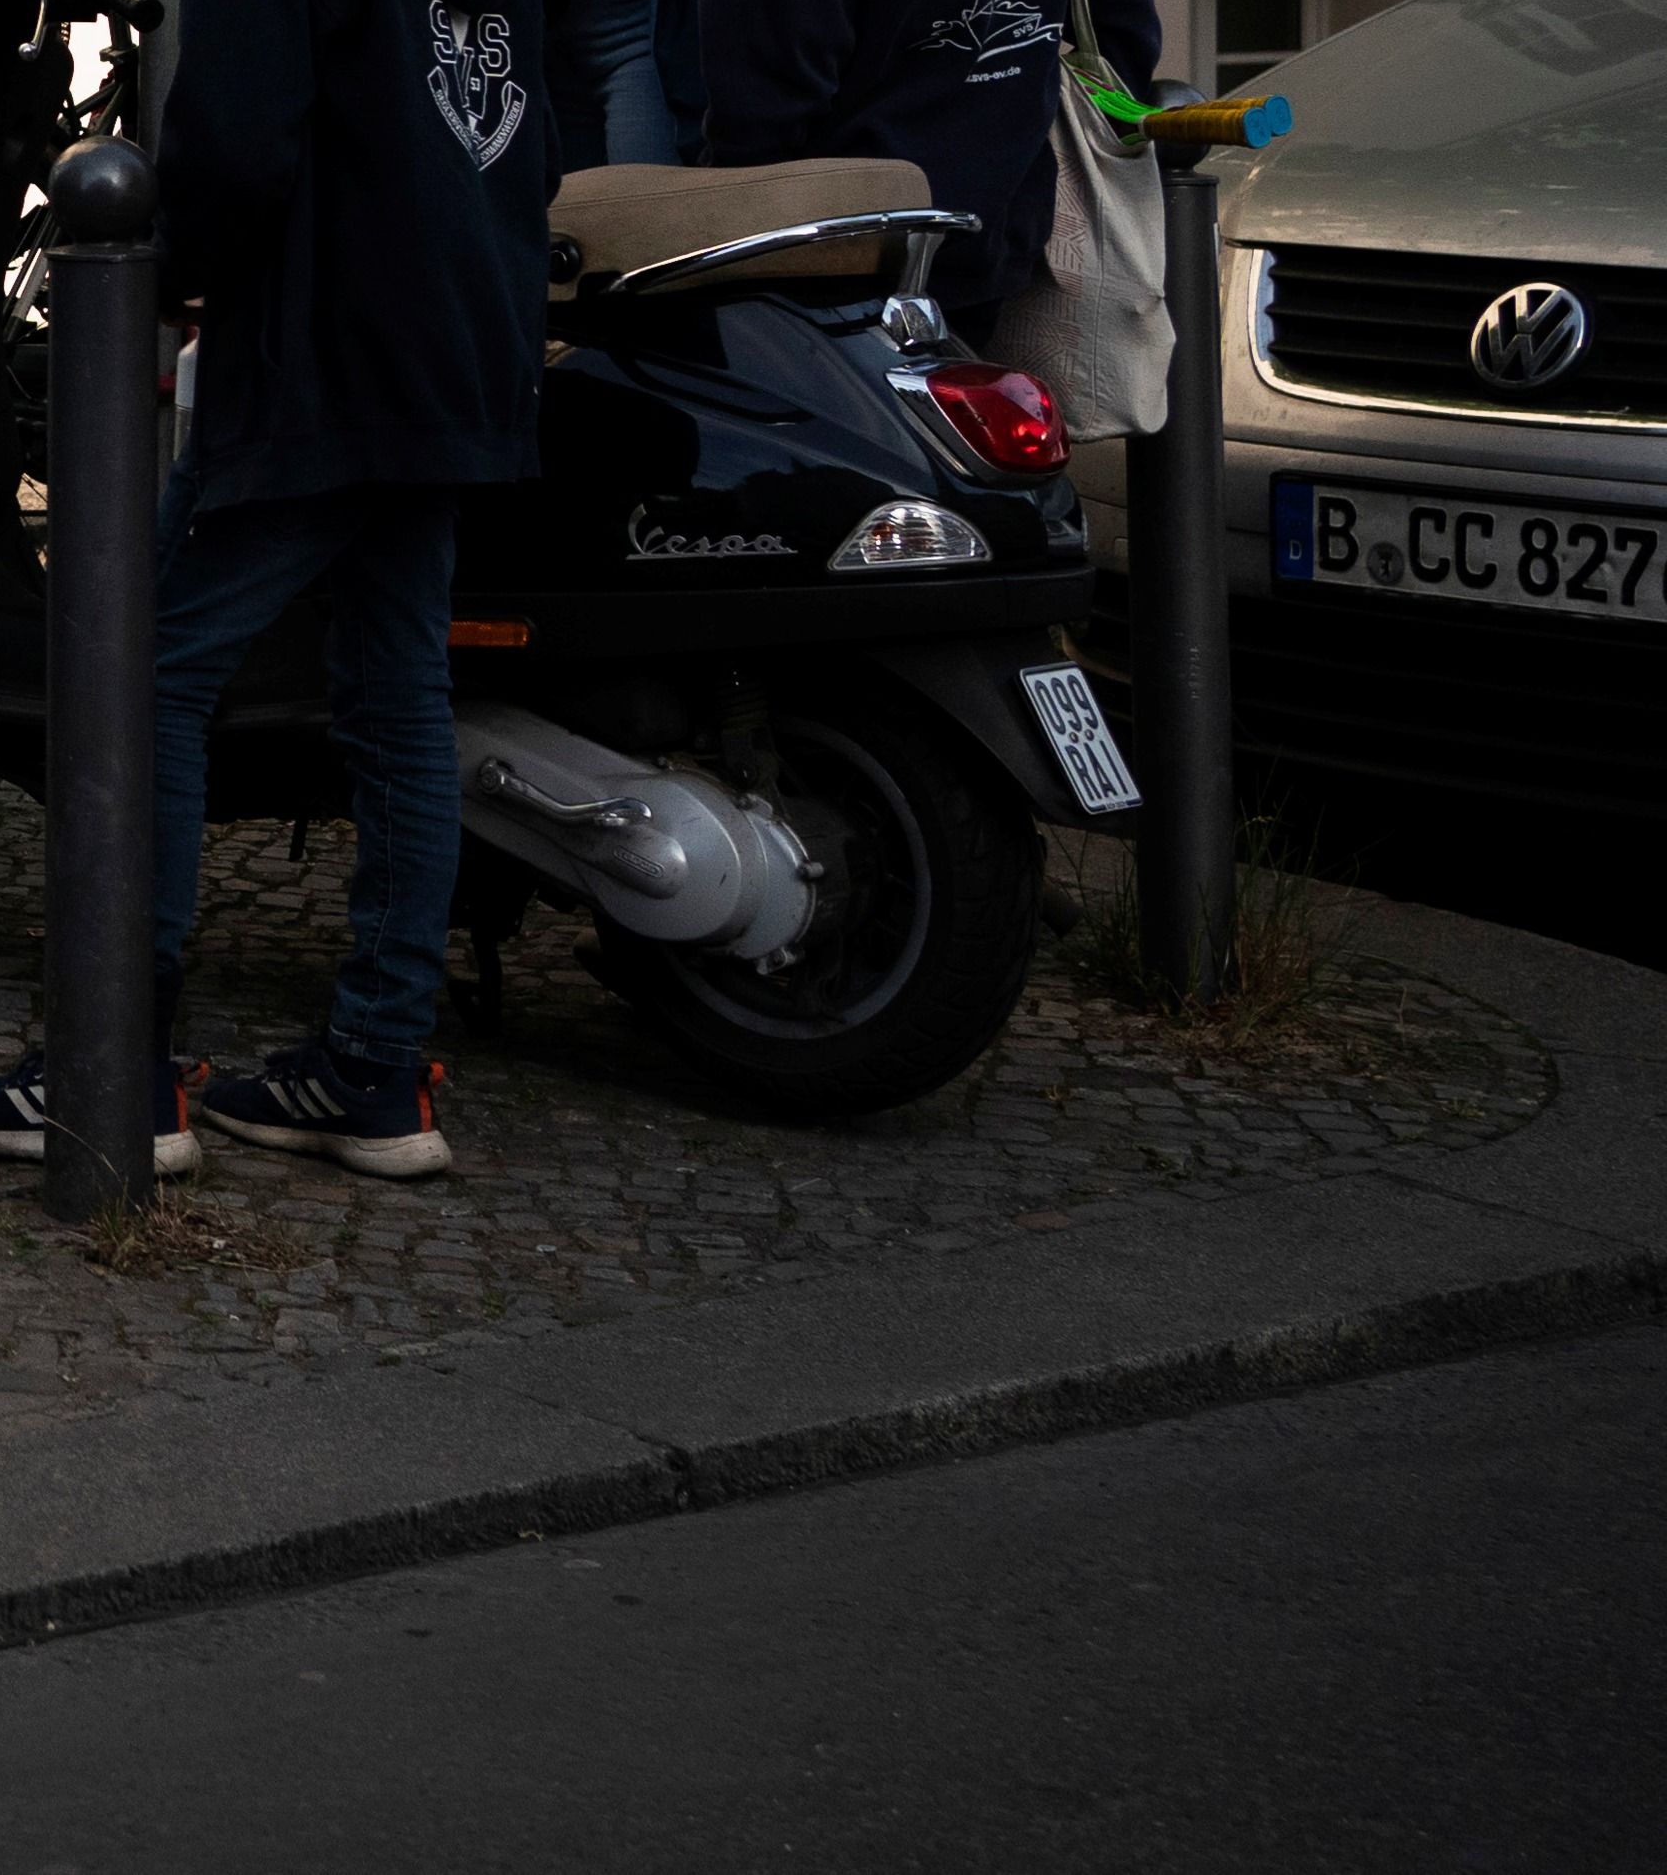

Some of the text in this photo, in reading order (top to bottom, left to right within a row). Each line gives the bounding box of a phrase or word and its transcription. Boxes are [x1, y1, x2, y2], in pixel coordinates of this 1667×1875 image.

[626, 502, 799, 558] Vespa
[1318, 495, 1360, 573] B
[1409, 506, 1498, 590] CC
[1517, 517, 1667, 608] 827
[1034, 674, 1099, 735] 099
